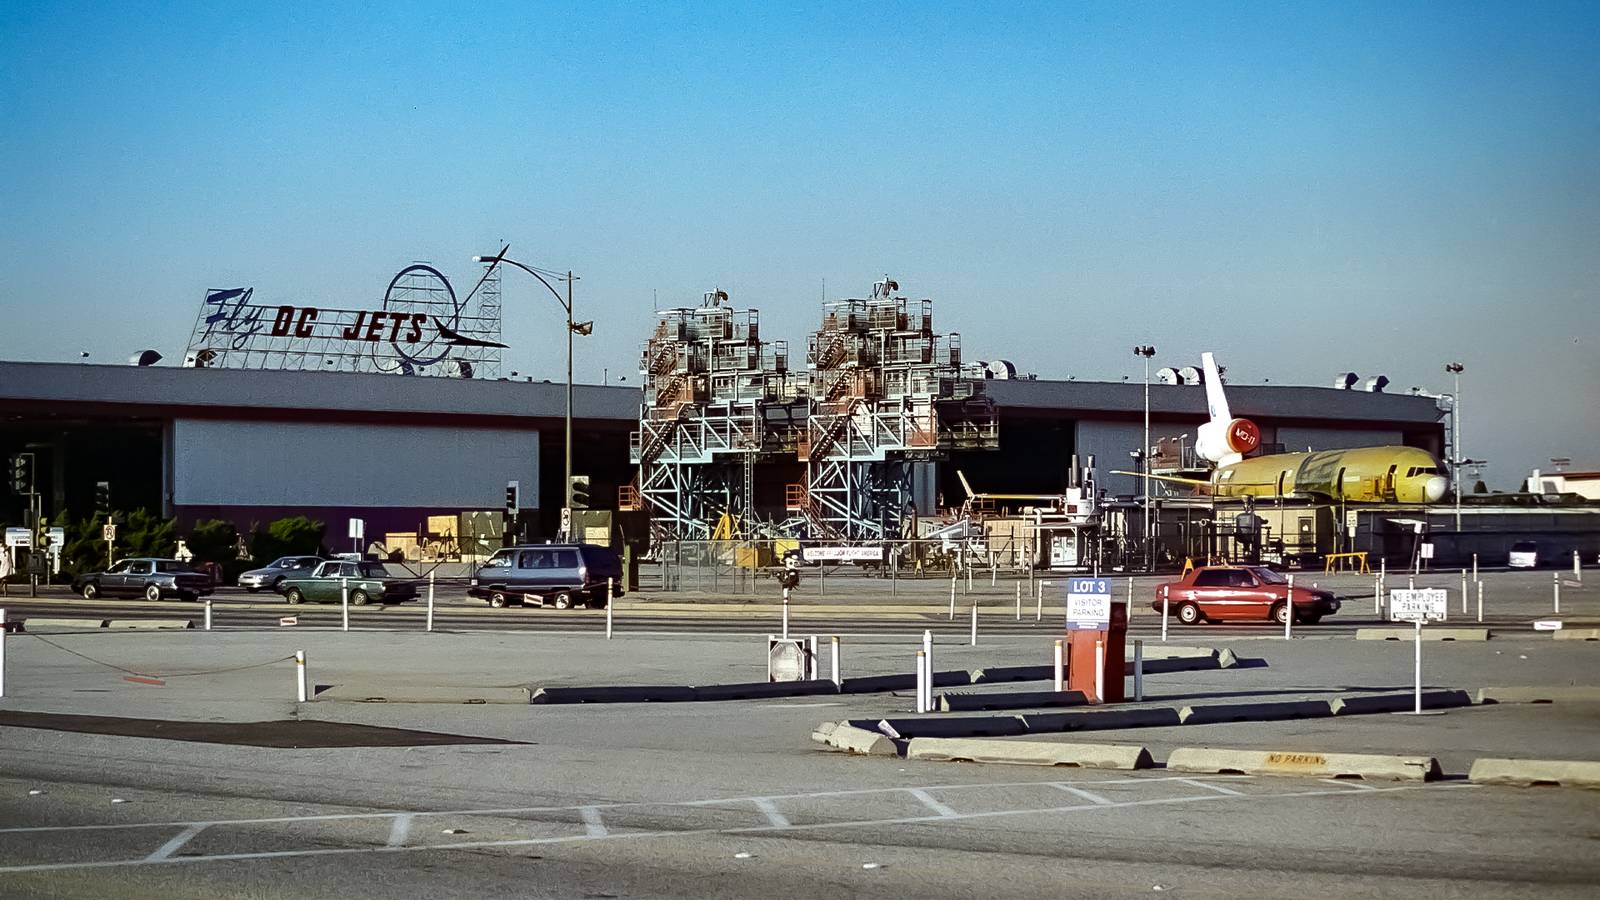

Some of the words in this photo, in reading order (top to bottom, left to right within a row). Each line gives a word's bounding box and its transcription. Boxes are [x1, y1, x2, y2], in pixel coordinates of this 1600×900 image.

[201, 287, 264, 350] Fly
[271, 306, 318, 338] DC
[343, 310, 427, 344] JETS
[1235, 427, 1256, 445] MD-11
[1073, 580, 1095, 593] LOT
[1097, 580, 1106, 593] 3
[1392, 592, 1402, 602] NO
[1406, 592, 1444, 602] EMPLOYEE
[1074, 598, 1102, 607] VISITOR
[1402, 602, 1435, 612] PARKING
[1072, 608, 1105, 617] PARKING
[1269, 754, 1282, 763] NO
